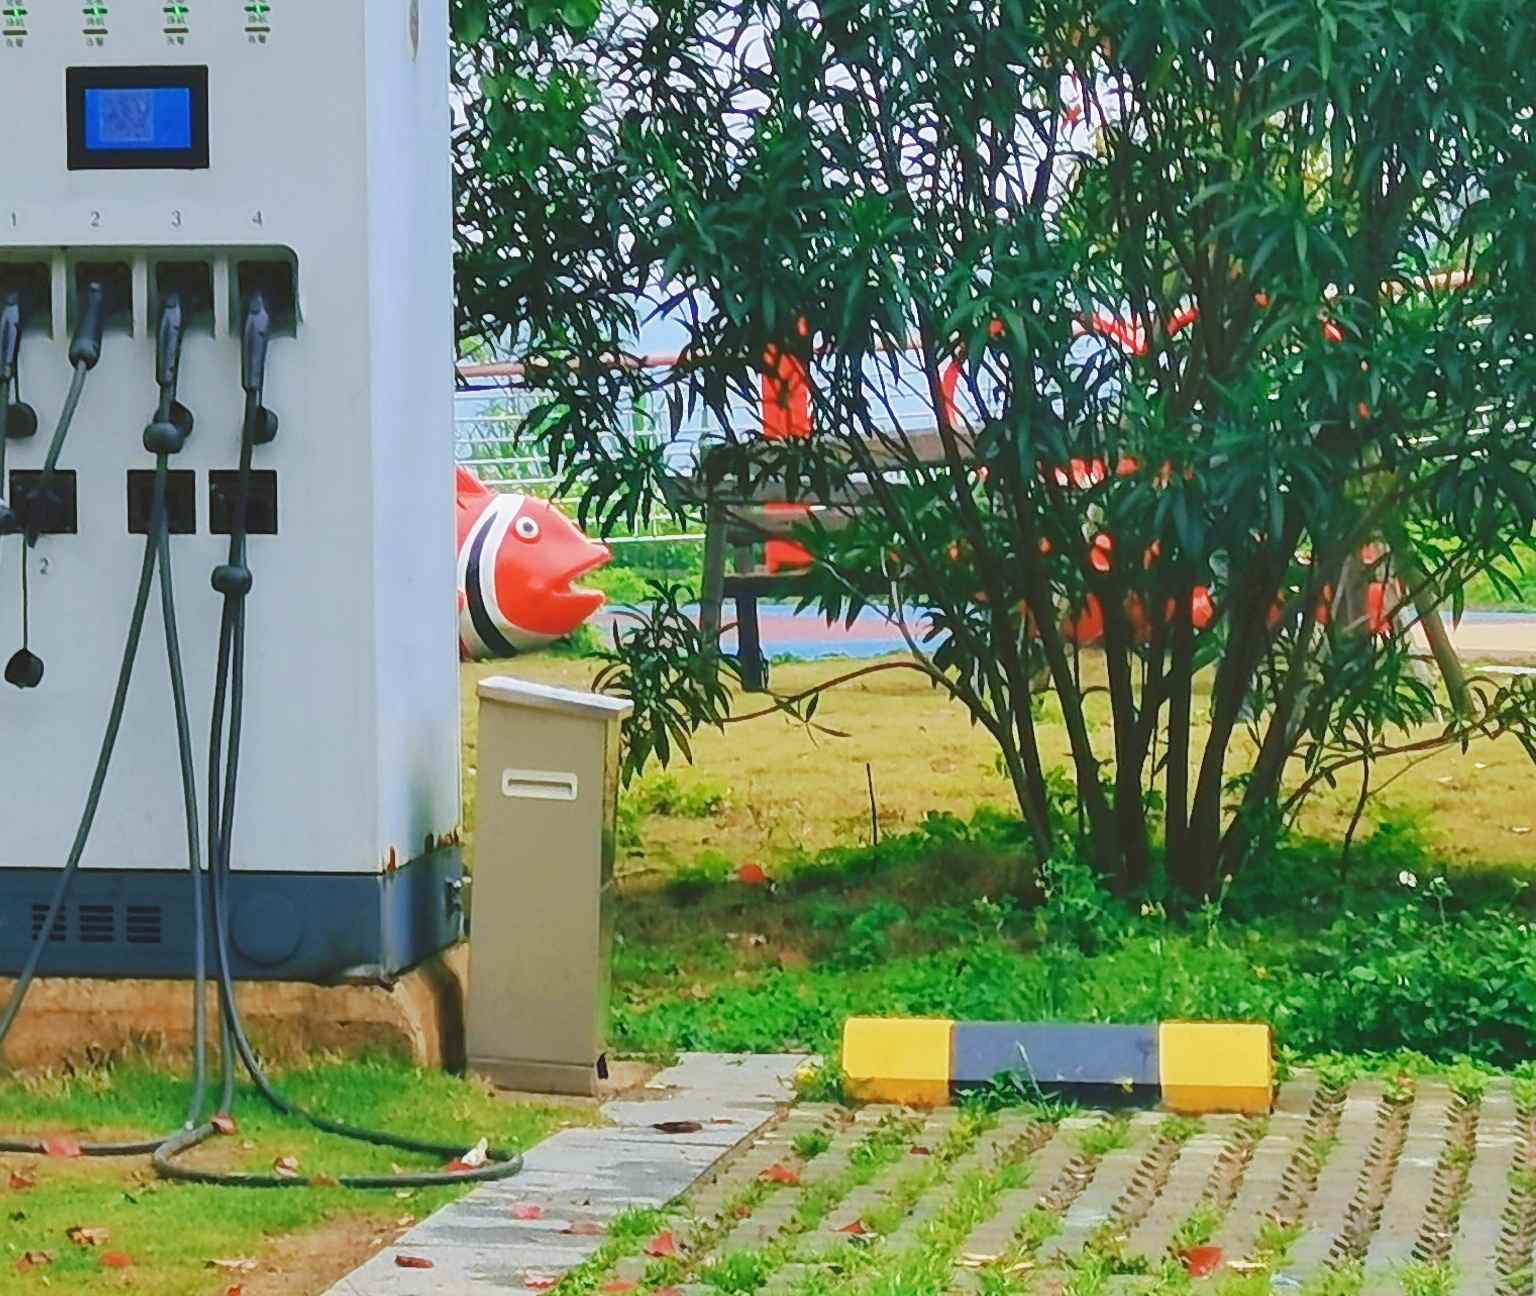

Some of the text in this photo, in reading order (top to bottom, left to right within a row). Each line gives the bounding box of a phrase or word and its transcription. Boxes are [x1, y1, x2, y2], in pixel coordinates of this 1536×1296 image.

[10, 212, 17, 227] 1
[90, 211, 101, 227] 2
[171, 211, 182, 227] 3
[251, 211, 263, 227] 4
[39, 558, 49, 574] 2
